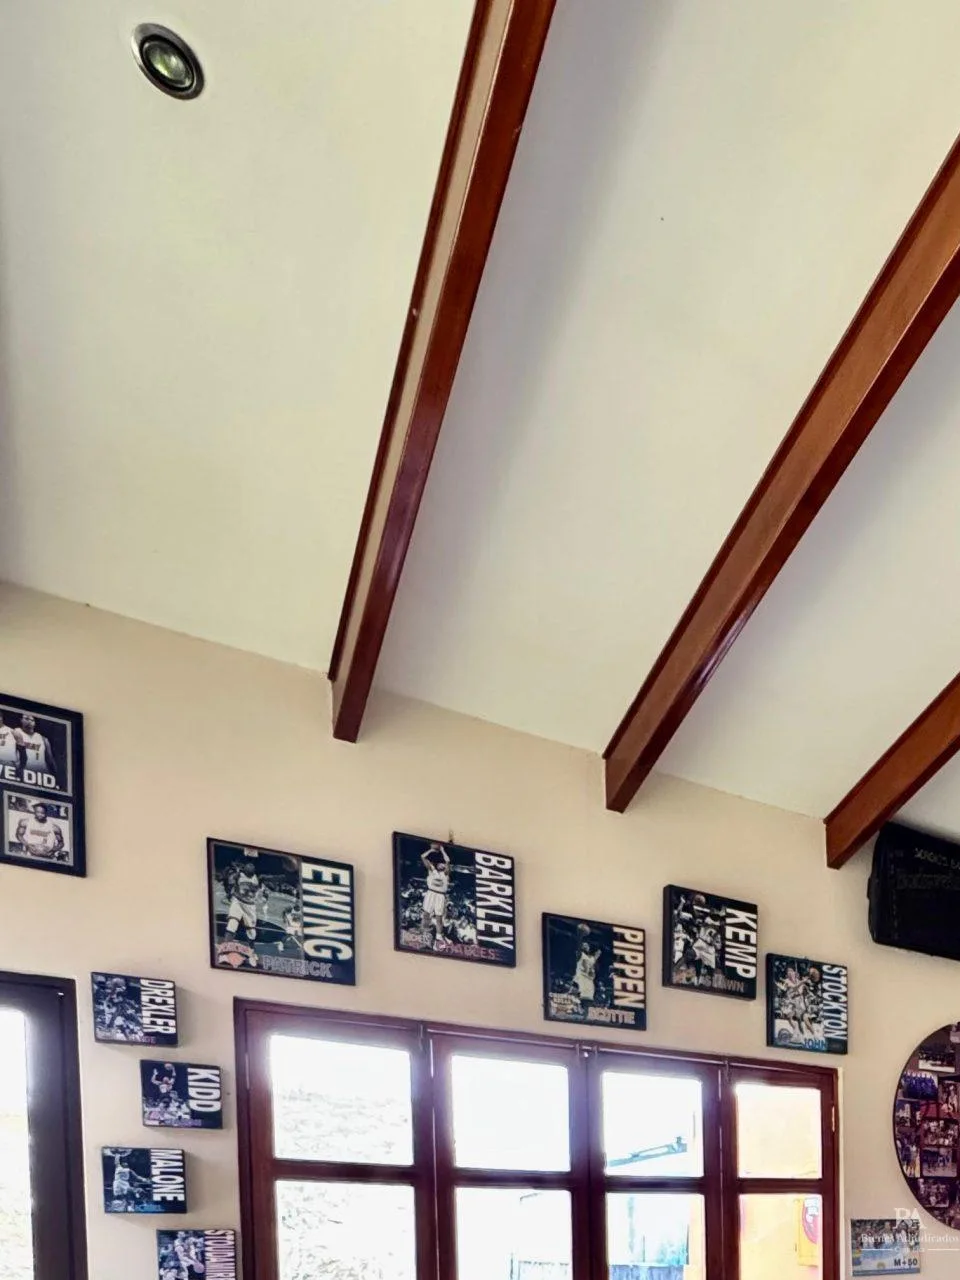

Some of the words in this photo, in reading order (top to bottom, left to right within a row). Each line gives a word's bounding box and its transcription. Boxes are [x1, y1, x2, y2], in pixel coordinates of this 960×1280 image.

[0, 764, 21, 781] E.
[24, 769, 60, 790] DID.
[301, 862, 353, 961] EWING
[475, 852, 514, 949] BARKLEY
[261, 954, 333, 978] PATRICK
[437, 941, 496, 959] CHARLES
[612, 926, 645, 1008] PIPPEN
[725, 908, 757, 979] KEMP
[140, 979, 177, 1034] DREXLER
[588, 1006, 636, 1024] SCOTTIE
[822, 965, 848, 1040] STOCKTON
[803, 1038, 827, 1050] JOHN
[187, 1067, 222, 1112] KIDD
[150, 1149, 185, 1201] MALONE
